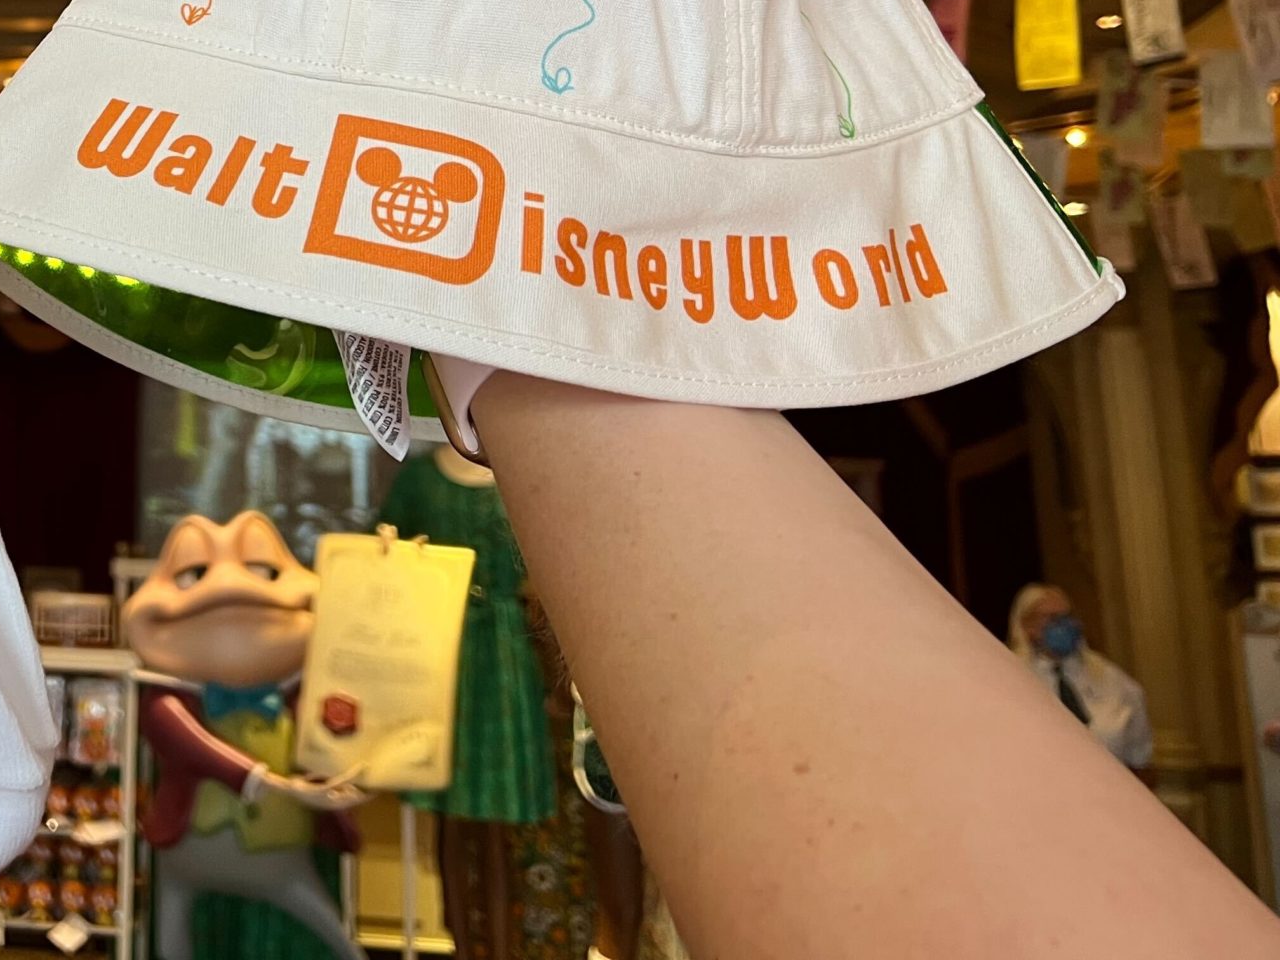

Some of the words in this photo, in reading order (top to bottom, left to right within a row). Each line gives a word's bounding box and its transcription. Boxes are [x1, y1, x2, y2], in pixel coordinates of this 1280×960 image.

[76, 97, 311, 220] Walt
[302, 113, 716, 325] Disney
[725, 223, 949, 322] World
